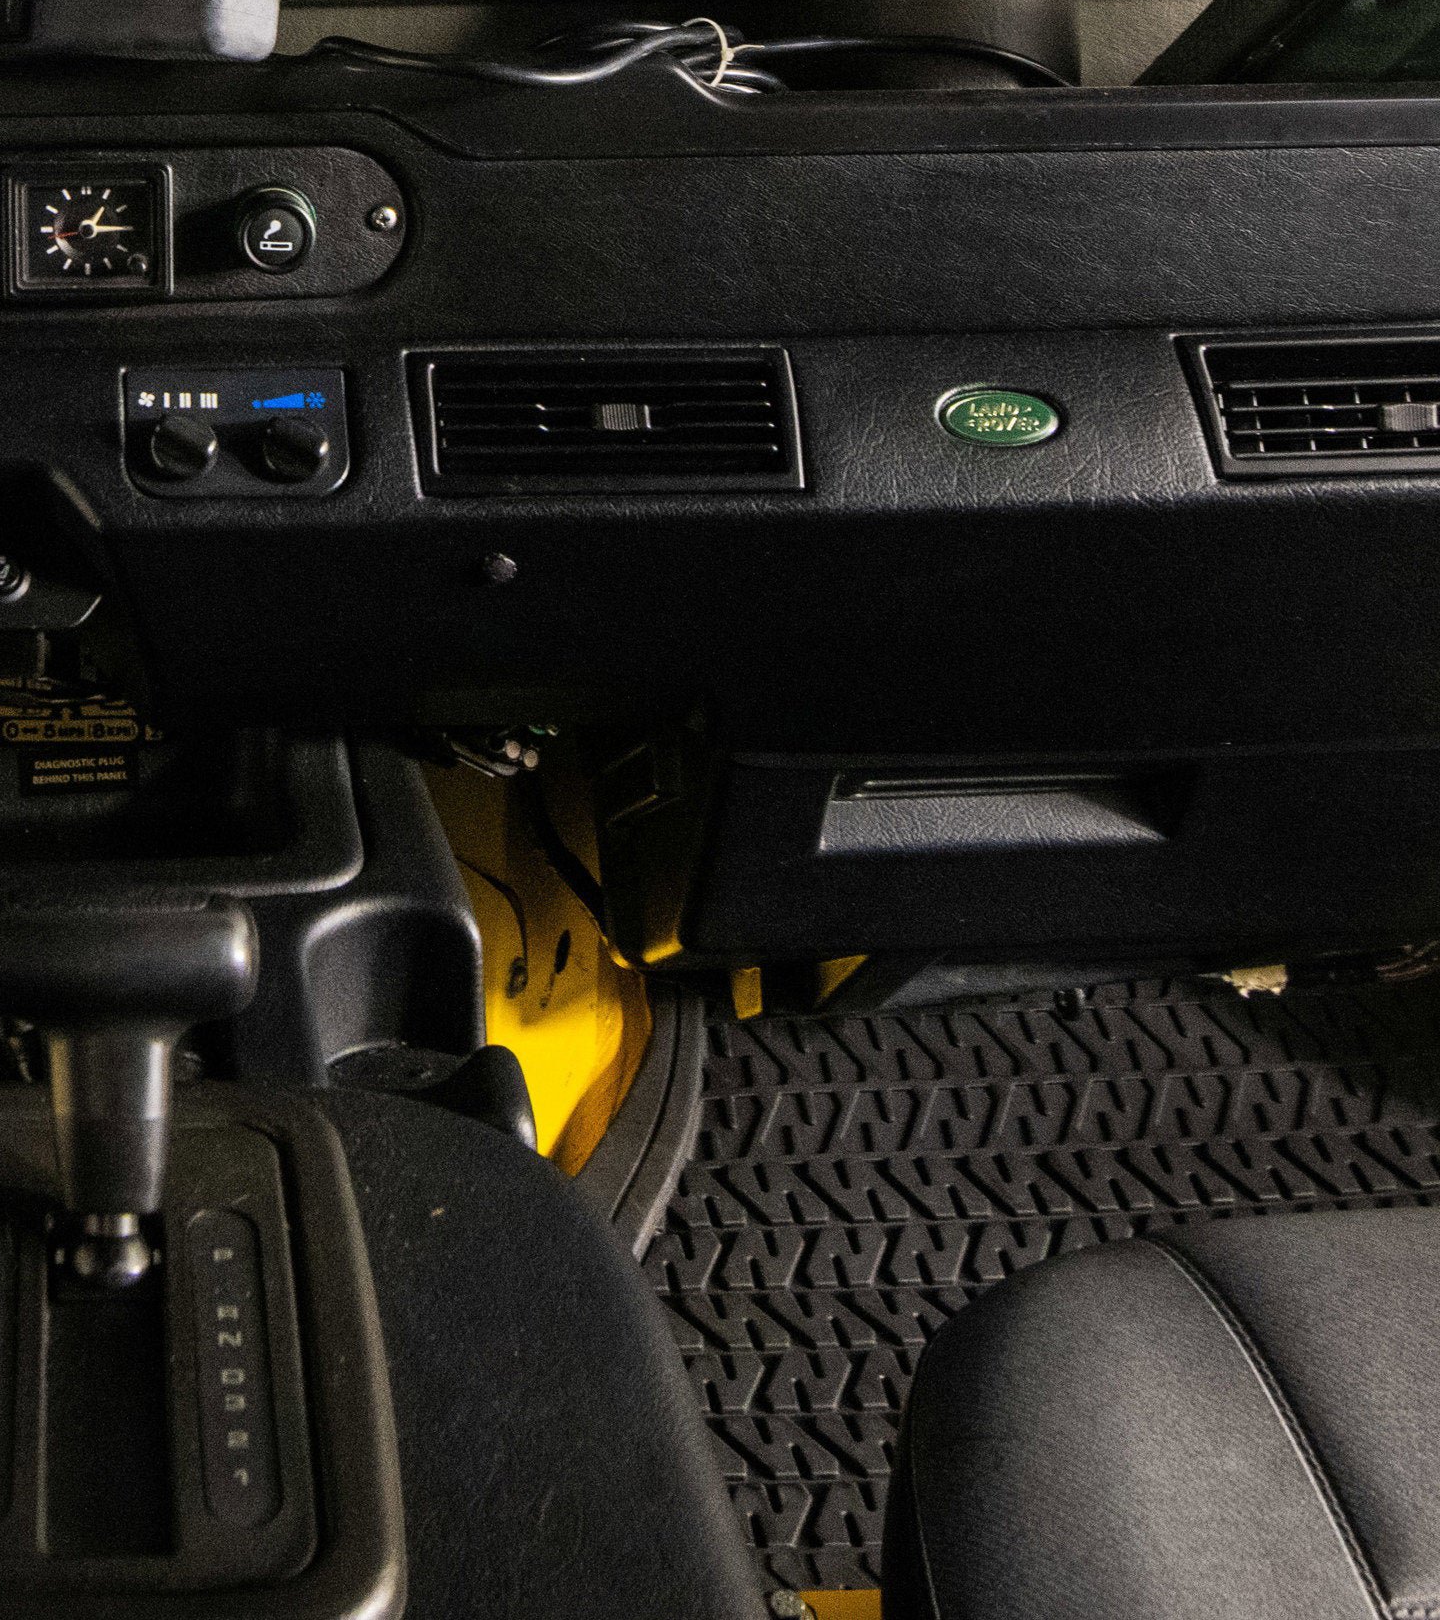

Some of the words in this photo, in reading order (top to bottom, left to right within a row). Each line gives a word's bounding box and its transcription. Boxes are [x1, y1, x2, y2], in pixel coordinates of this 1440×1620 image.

[33, 758, 95, 771] DIAGNOSTIC
[98, 756, 125, 767] PLUG
[31, 774, 71, 786] BEHIND
[72, 772, 95, 783] THIS
[96, 770, 128, 782] PANEL
[217, 1331, 242, 1348] N
